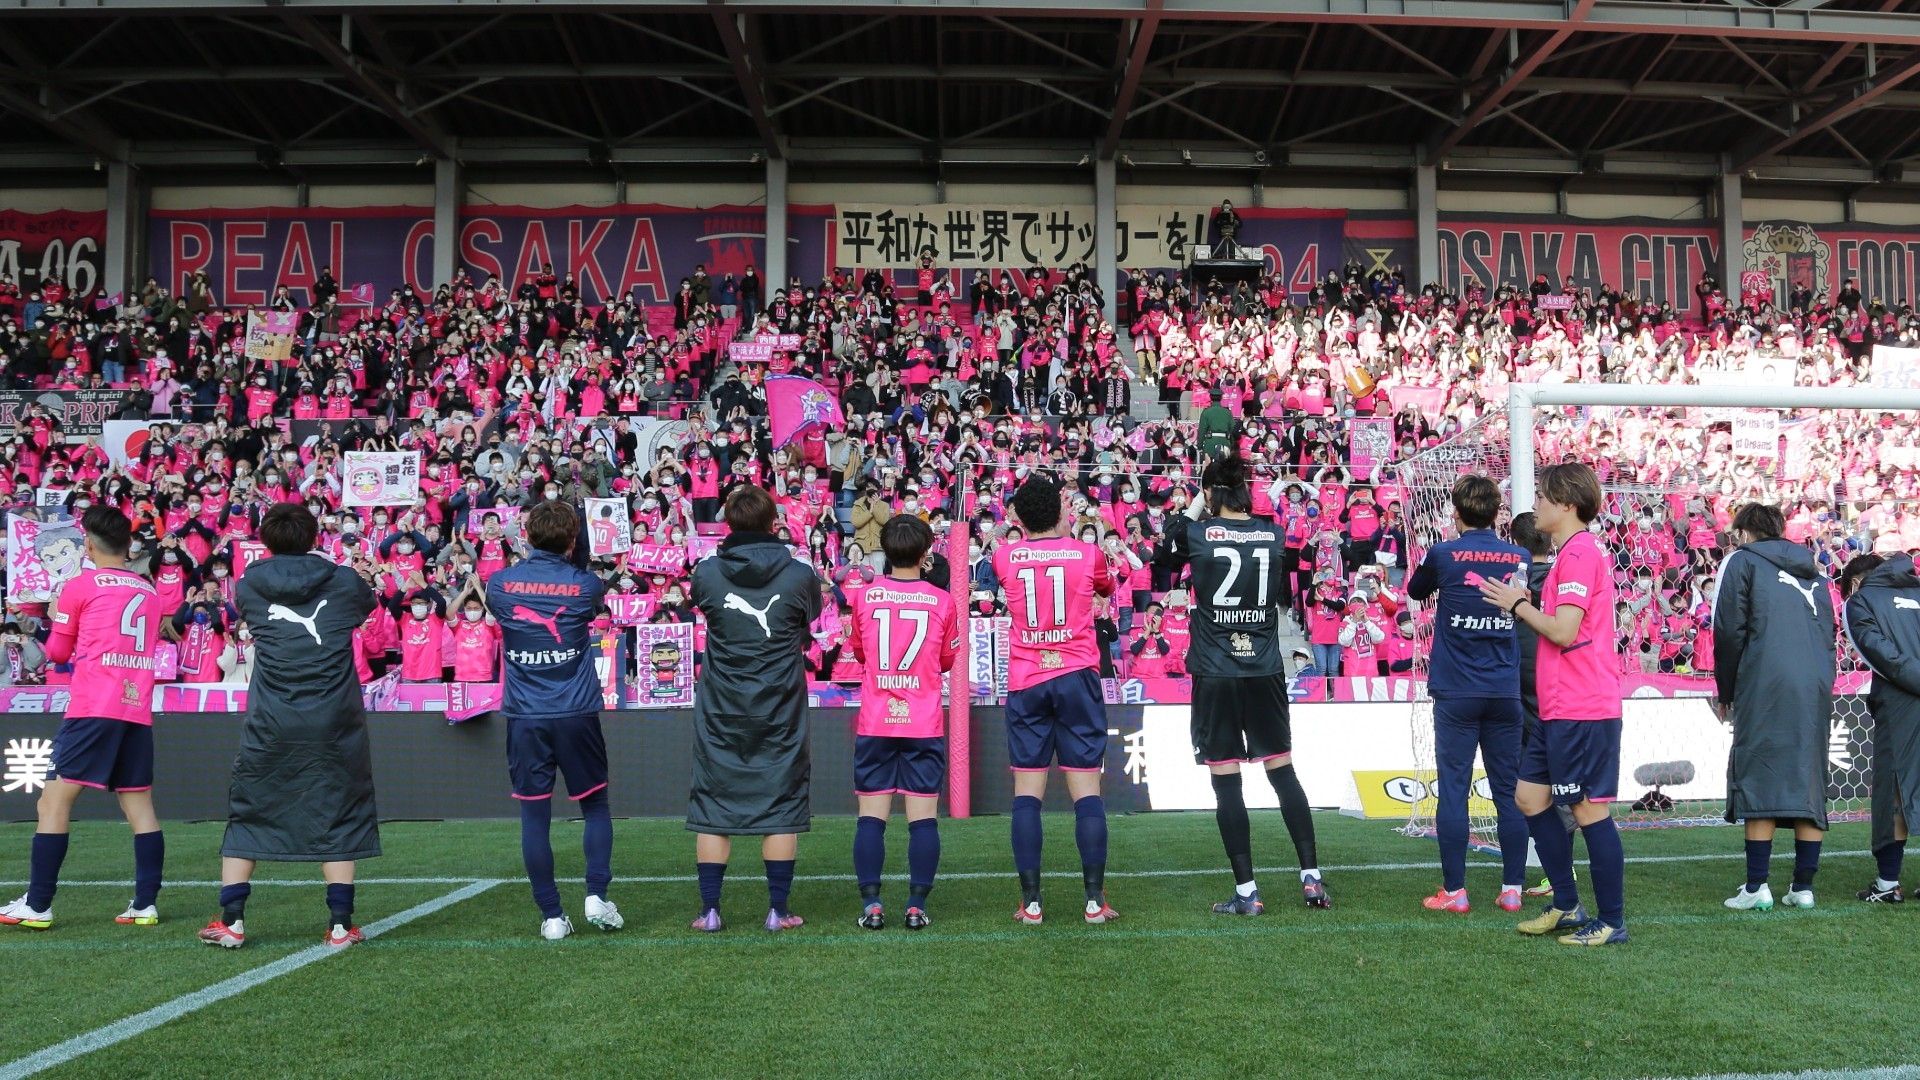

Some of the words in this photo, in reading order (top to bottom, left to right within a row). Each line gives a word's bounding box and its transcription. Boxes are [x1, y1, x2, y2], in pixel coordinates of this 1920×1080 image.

[170, 221, 353, 307] REAL
[1437, 228, 1603, 306] OSAKA
[1620, 233, 1719, 312] CITY
[98, 391, 124, 402] spirit
[1227, 531, 1274, 542] Nipponham
[1031, 551, 1080, 560] Nipponham
[1451, 550, 1521, 563] YANMAR
[1212, 547, 1270, 606] 21
[503, 582, 581, 597] YANMAR
[1016, 566, 1066, 628] 11
[1559, 584, 1585, 595] SHARP
[886, 592, 937, 604] Nipponham
[120, 593, 145, 652] 4
[1213, 610, 1266, 623] JINHYEON
[872, 607, 930, 671] 17
[876, 675, 920, 690] TOKUMA
[884, 717, 912, 725] SINGHA
[2, 739, 53, 793] 業
